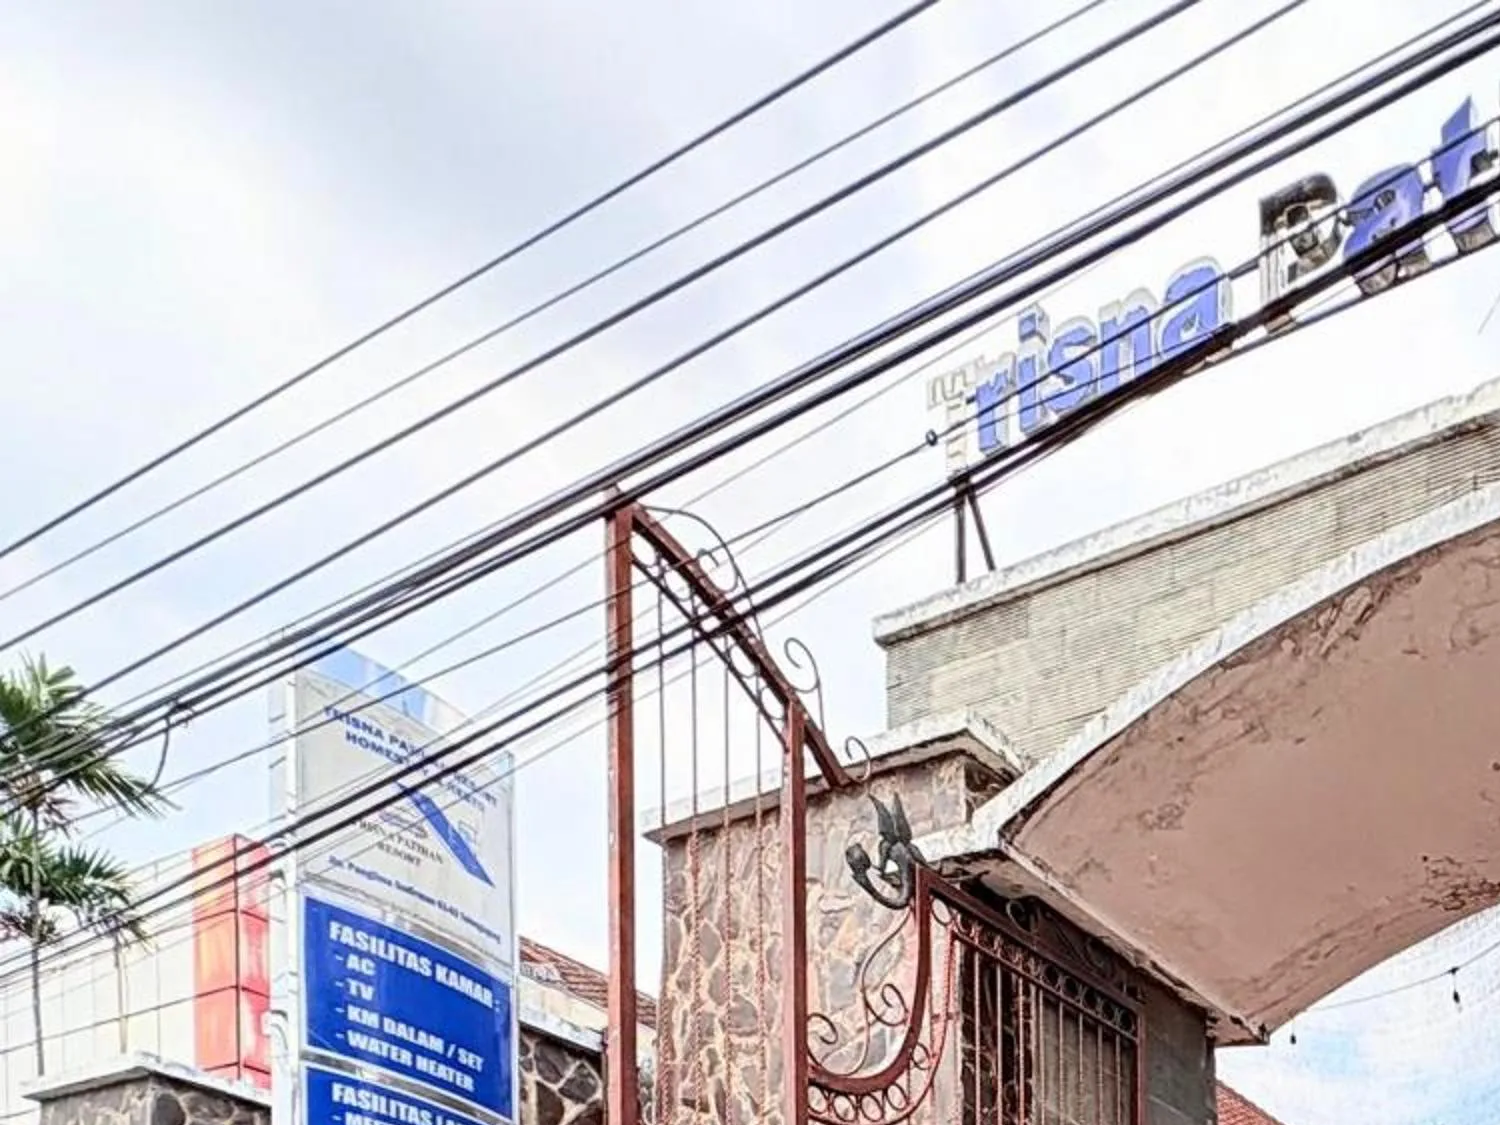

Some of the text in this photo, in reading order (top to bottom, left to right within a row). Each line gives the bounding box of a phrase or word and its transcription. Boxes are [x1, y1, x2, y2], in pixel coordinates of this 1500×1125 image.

[329, 921, 432, 978] FASILITAS
[346, 954, 376, 976] AC
[346, 978, 375, 1002] TV
[346, 1029, 476, 1093] WATER HEATER
[347, 1003, 380, 1029] KM
[383, 1016, 445, 1056] DALAM
[457, 1047, 484, 1073] SET
